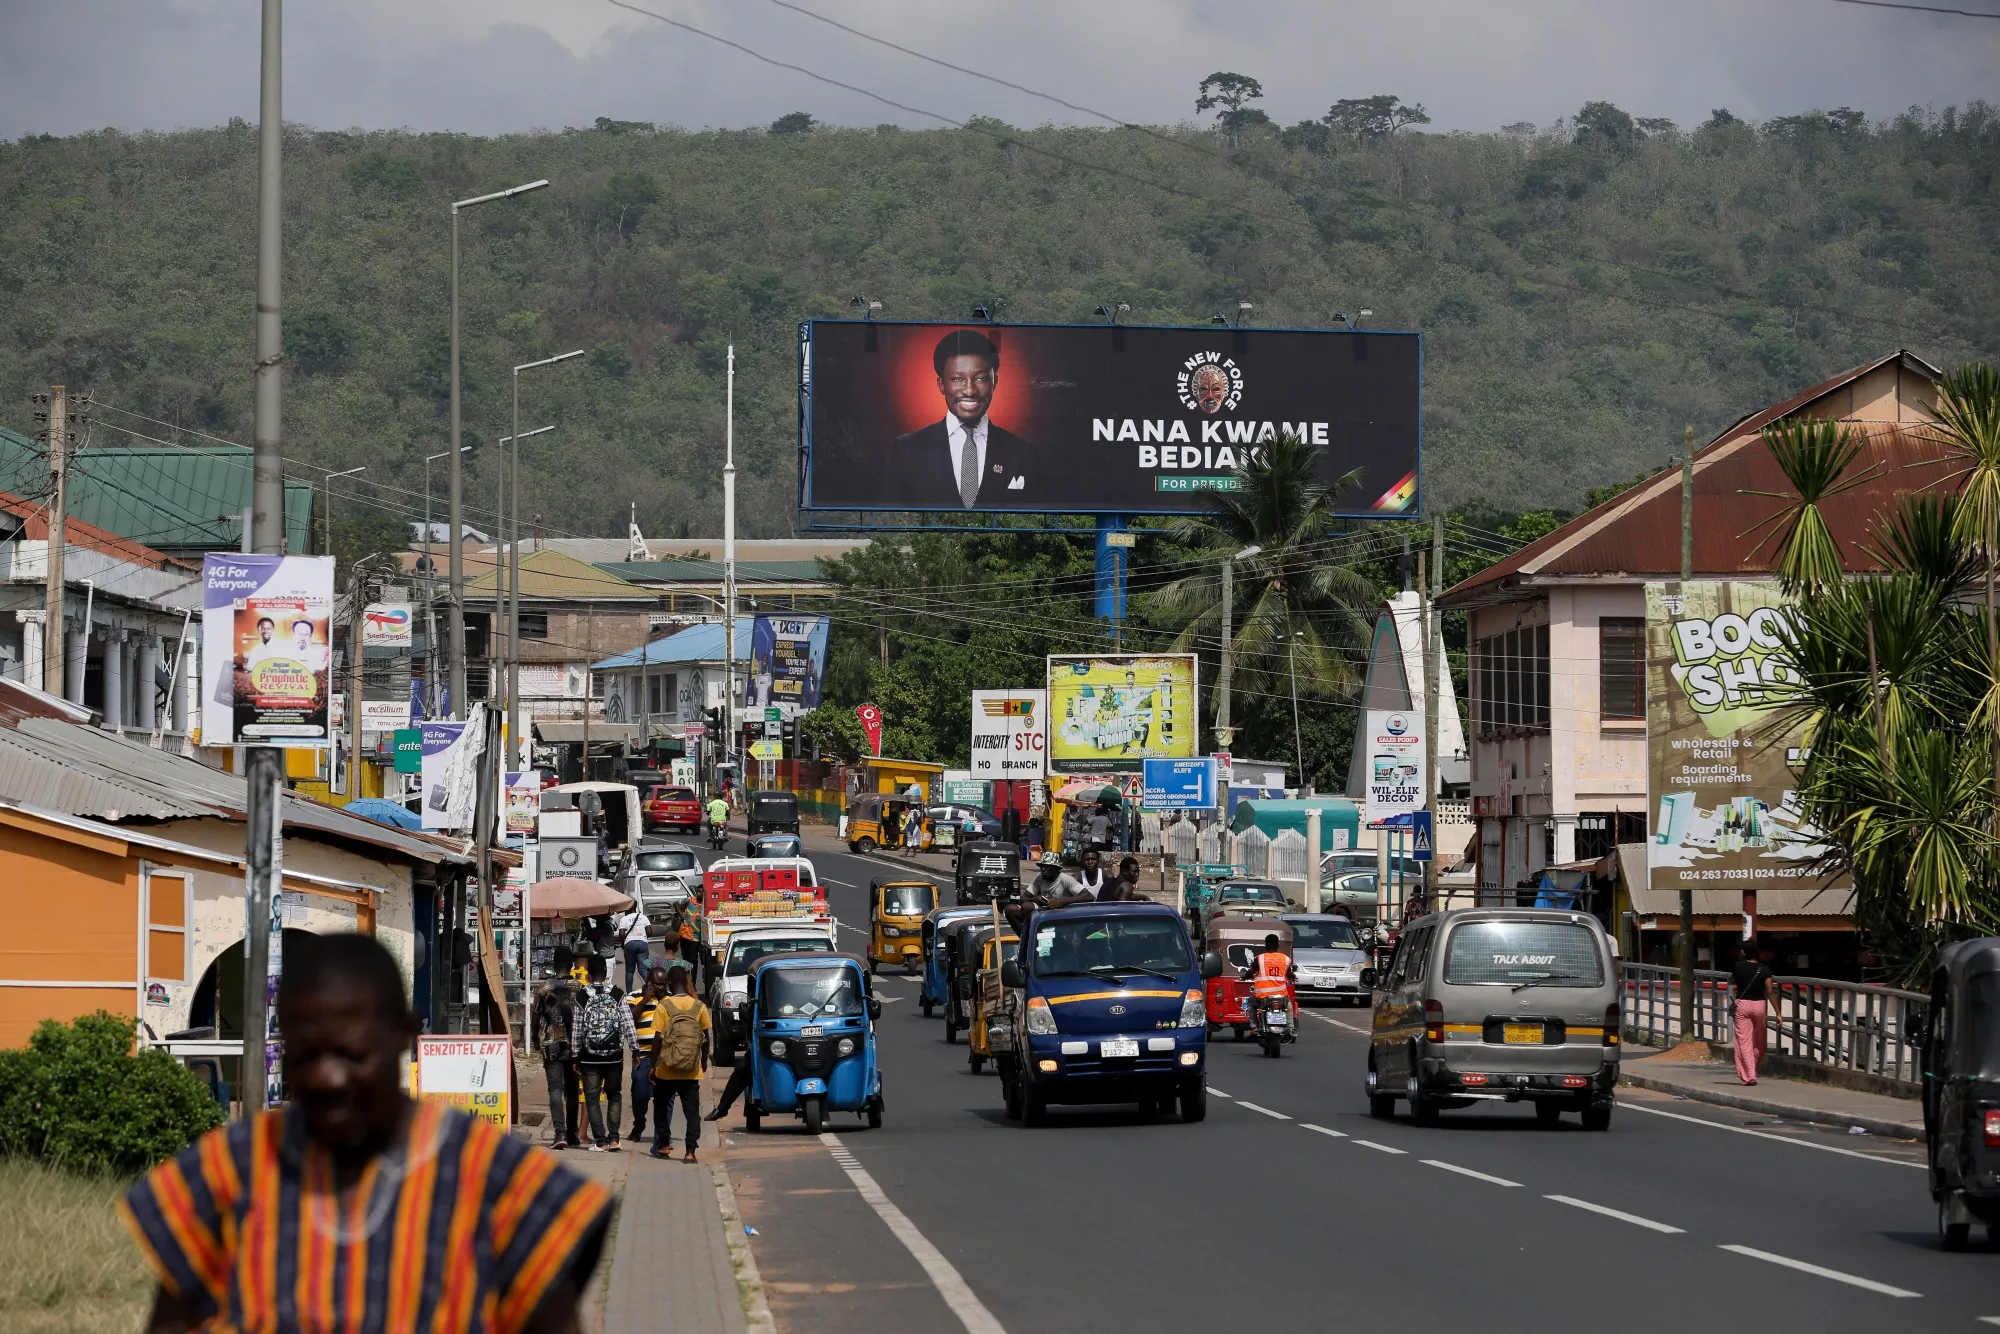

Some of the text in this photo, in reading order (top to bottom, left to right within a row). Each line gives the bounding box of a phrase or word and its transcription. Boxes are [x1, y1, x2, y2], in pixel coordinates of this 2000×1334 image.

[1184, 350, 1221, 371] NEW
[1222, 358, 1244, 411] FORCE
[1093, 418, 1329, 444] NANA KWAME
[1138, 445, 1272, 469] BEDIAK
[1162, 479, 1250, 490] FOR PRESID
[208, 566, 249, 578] 4G For
[207, 578, 258, 590] Everyone
[366, 632, 409, 640] TotalEnergies
[260, 672, 308, 684] Prophetic
[1684, 653, 1815, 706] SHO
[368, 704, 404, 714] excellium
[398, 741, 422, 751] ente
[973, 732, 1044, 751] INTERCITY STC
[1671, 737, 1753, 749] wholesale &
[1126, 747, 1138, 756] Buy
[1693, 748, 1732, 759] Retail
[978, 760, 1038, 770] HO BRANCH
[1682, 764, 1738, 777] Boarding
[1670, 773, 1752, 785] requirements
[1371, 786, 1420, 794] WIL-ELIK
[1377, 794, 1415, 802] DECOR
[1679, 870, 1700, 880] 024
[1702, 870, 1721, 880] 263
[1723, 869, 1748, 879] 7033
[1755, 868, 1775, 878] 024
[1777, 868, 1797, 878] 422
[1493, 954, 1555, 965] TALK ABOUT
[423, 1043, 504, 1056] SENZOTEL ENT.
[437, 1092, 469, 1105] airtel
